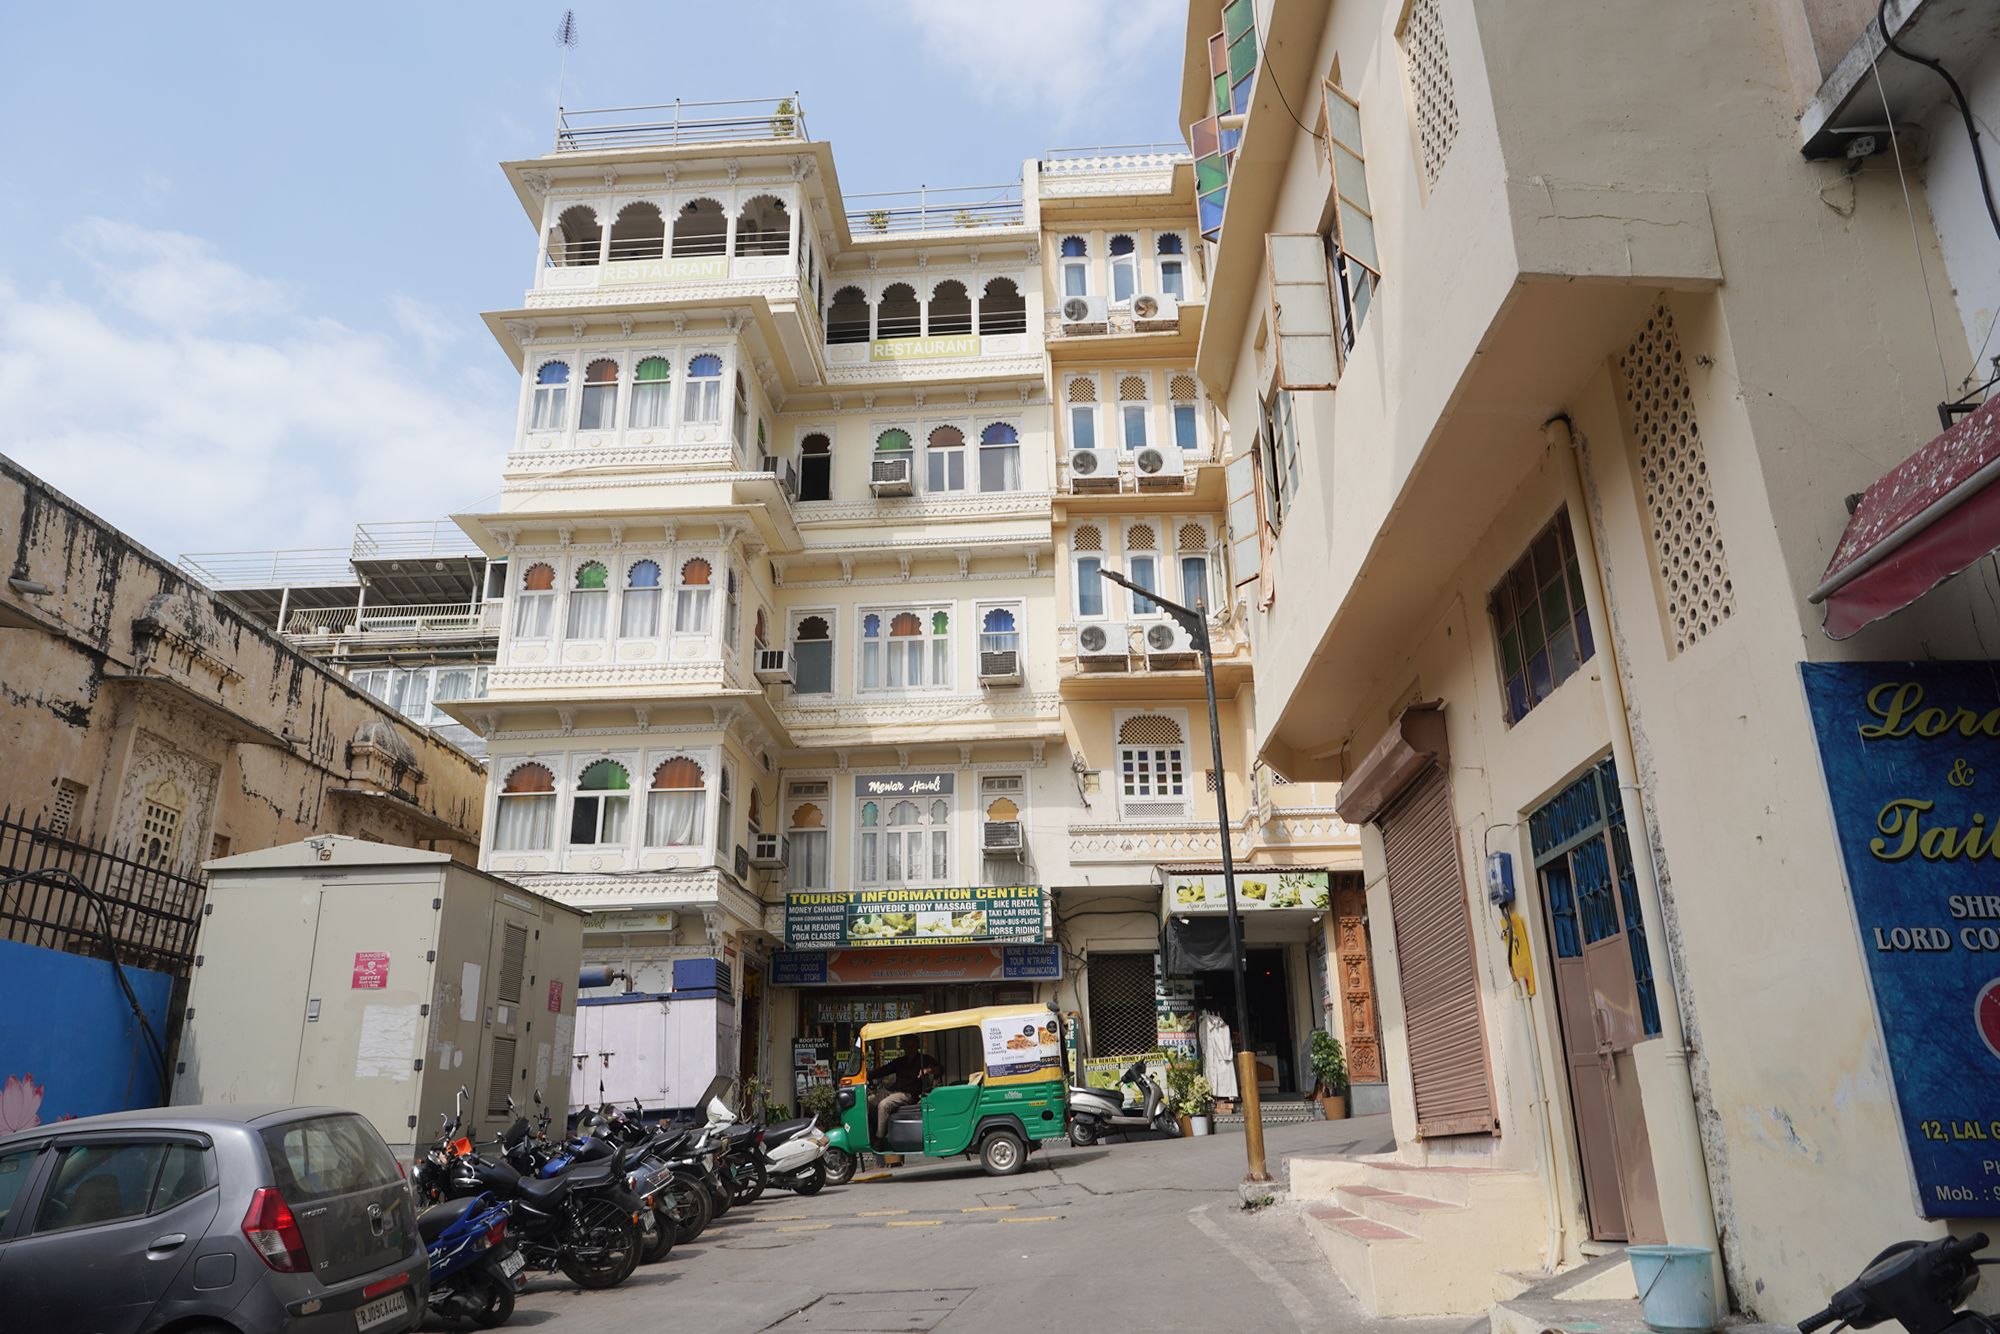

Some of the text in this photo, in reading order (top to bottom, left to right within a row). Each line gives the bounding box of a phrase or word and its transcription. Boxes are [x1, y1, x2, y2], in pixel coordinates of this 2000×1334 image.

[603, 262, 725, 280] RESTAURANT
[874, 339, 977, 357] RESTAURANT
[1948, 758, 1975, 787] &
[868, 776, 941, 794] Mewar Haveli
[790, 886, 1040, 905] TOURIST INFORMATION CENTER
[788, 905, 845, 914] MONEY CHANGER
[856, 902, 977, 914] AYURVEDIC BODY MASSAGE
[993, 899, 1039, 908] BIKE RENTAL
[1017, 908, 1041, 916] RENTAL
[583, 912, 607, 929] aveli
[792, 923, 840, 932] PALM READING
[989, 917, 1041, 925] TRAIN-BUS-FLIGHT
[792, 932, 840, 941] YOGA CLASSES
[989, 926, 1040, 935] HORSE RIDING
[1873, 927, 2000, 951] LORD CO
[821, 1012, 859, 1021] AYUVEDC
[880, 1010, 911, 1020] ASSGE
[1921, 1120, 1949, 1143] 12,
[1951, 1121, 1987, 1139] LAL
[1936, 1185, 1978, 1201] Mob.
